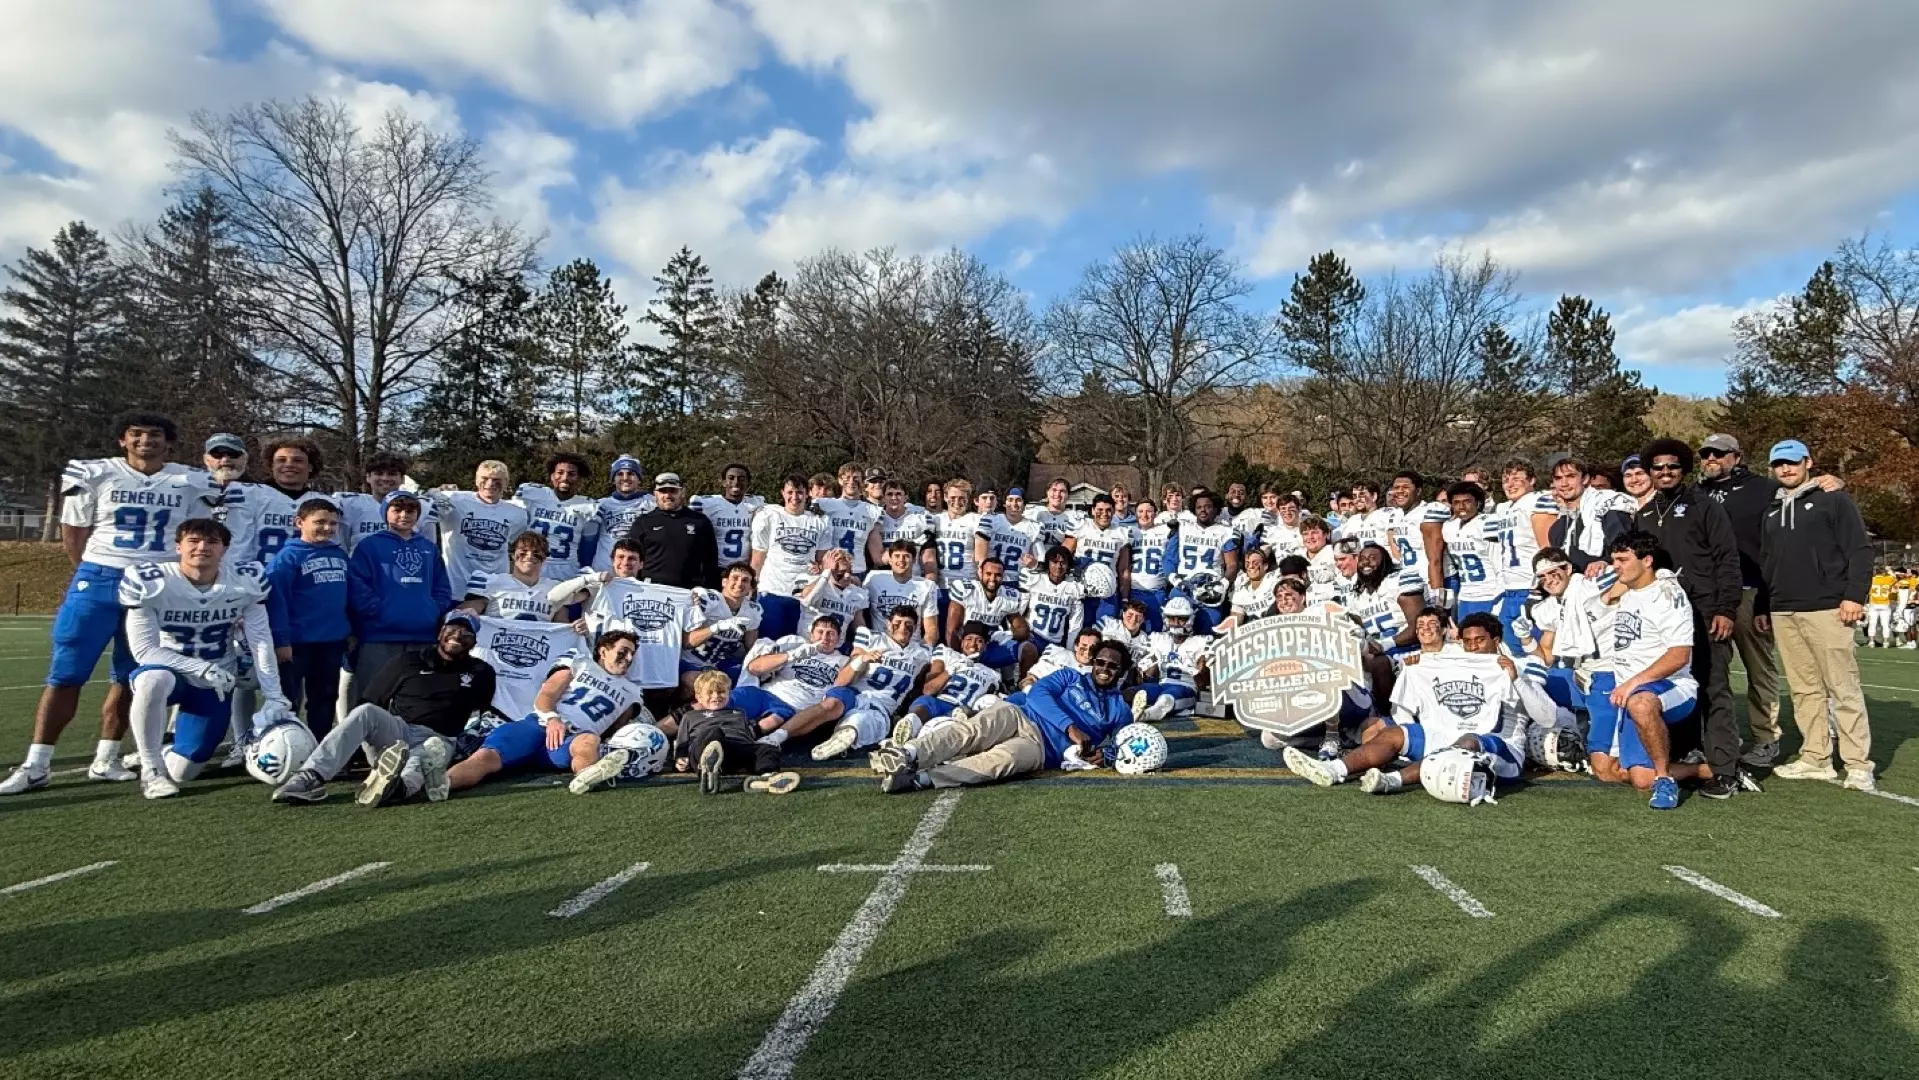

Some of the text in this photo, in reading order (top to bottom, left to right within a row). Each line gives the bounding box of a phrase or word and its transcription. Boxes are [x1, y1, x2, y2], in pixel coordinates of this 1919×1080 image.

[111, 490, 183, 508] GENERALS
[264, 513, 297, 526] GENE
[535, 507, 578, 527] GENERALS
[716, 517, 751, 528] GENERAL
[832, 517, 867, 531] GENERALS
[113, 507, 171, 552] 91
[882, 530, 916, 540] ENERALS
[994, 533, 1027, 547] GENERALS
[257, 527, 301, 567] 8
[723, 529, 745, 558] 9
[839, 529, 855, 556] 4
[1184, 534, 1219, 547] GENERALS
[993, 543, 1023, 571] 12
[1182, 545, 1216, 570] 54
[623, 599, 675, 617] CHESAPEAKE
[1038, 592, 1070, 607] GENERALS
[163, 607, 238, 624] GENERALS
[1033, 603, 1068, 634] 90
[1240, 614, 1322, 635] 2025 CHAMPIONS
[160, 623, 233, 659] 39
[492, 633, 550, 660] CHESAPEAKE
[883, 656, 918, 675] ENERALS
[1215, 626, 1355, 686] CHESAPEAKE
[577, 673, 625, 707] GENERALS
[1229, 669, 1343, 694] CHALLENGE
[1434, 680, 1485, 701] CHESAPEAKE
